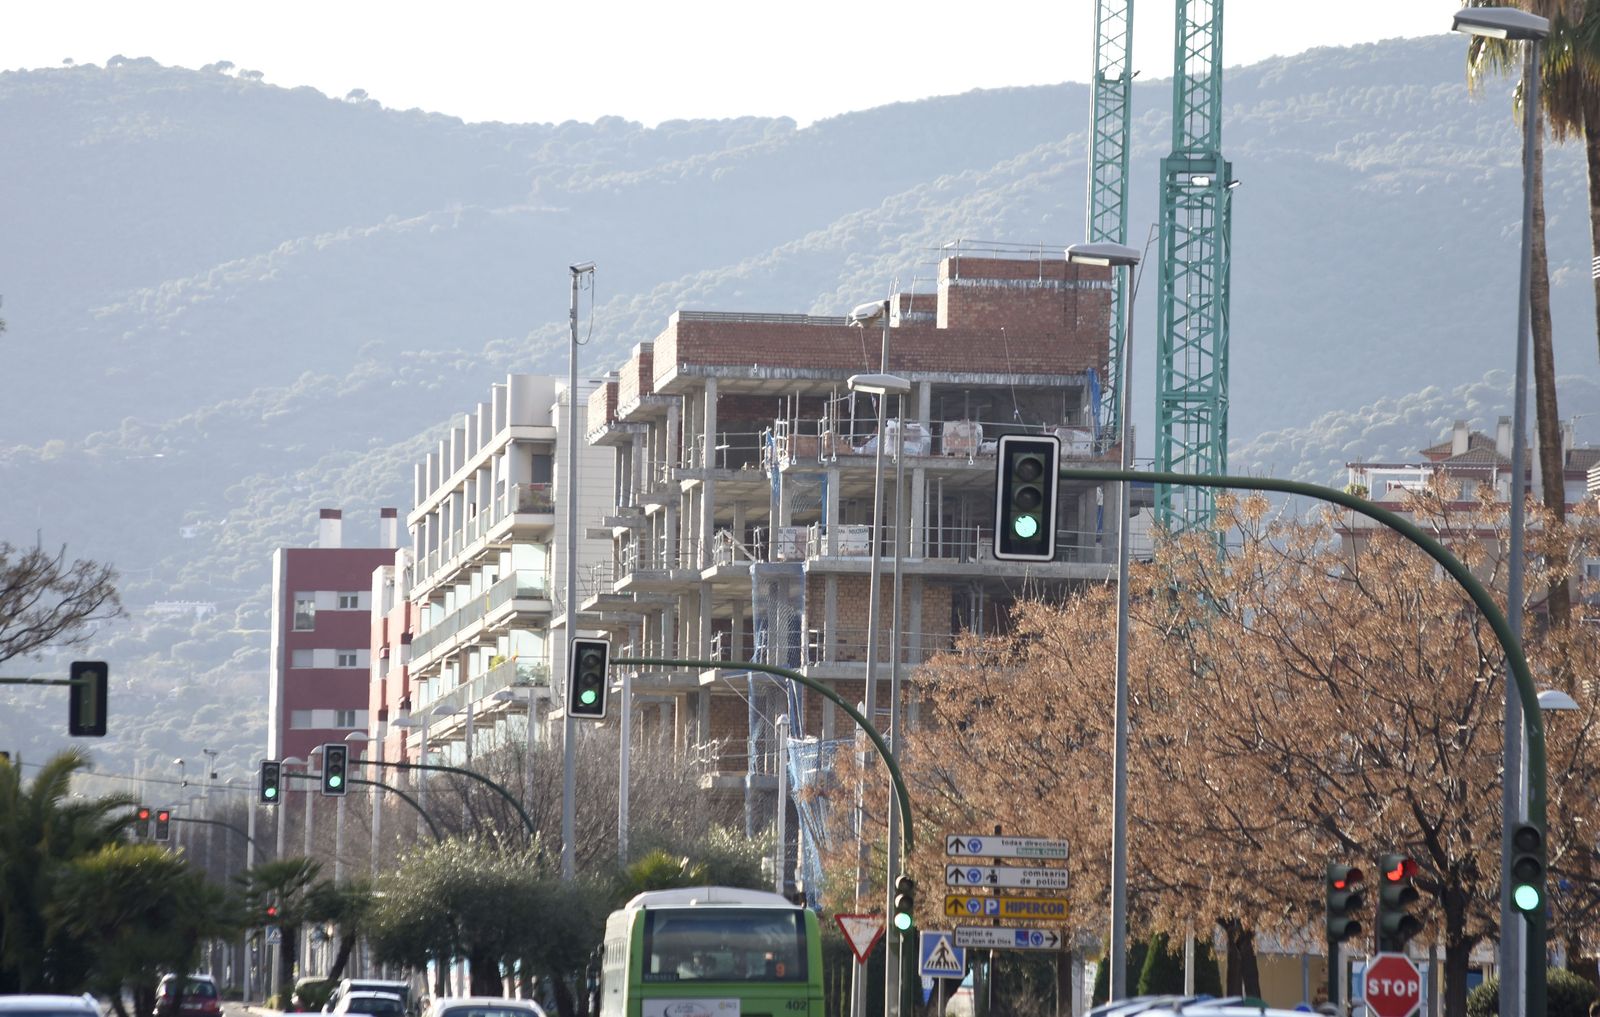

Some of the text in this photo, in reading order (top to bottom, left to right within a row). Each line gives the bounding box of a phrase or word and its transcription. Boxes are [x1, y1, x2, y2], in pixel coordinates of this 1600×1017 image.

[1024, 840, 1066, 848] direcciones
[1005, 901, 1065, 914] HIPERCOR
[1368, 978, 1418, 997] STOP
[785, 1000, 807, 1011] 402
